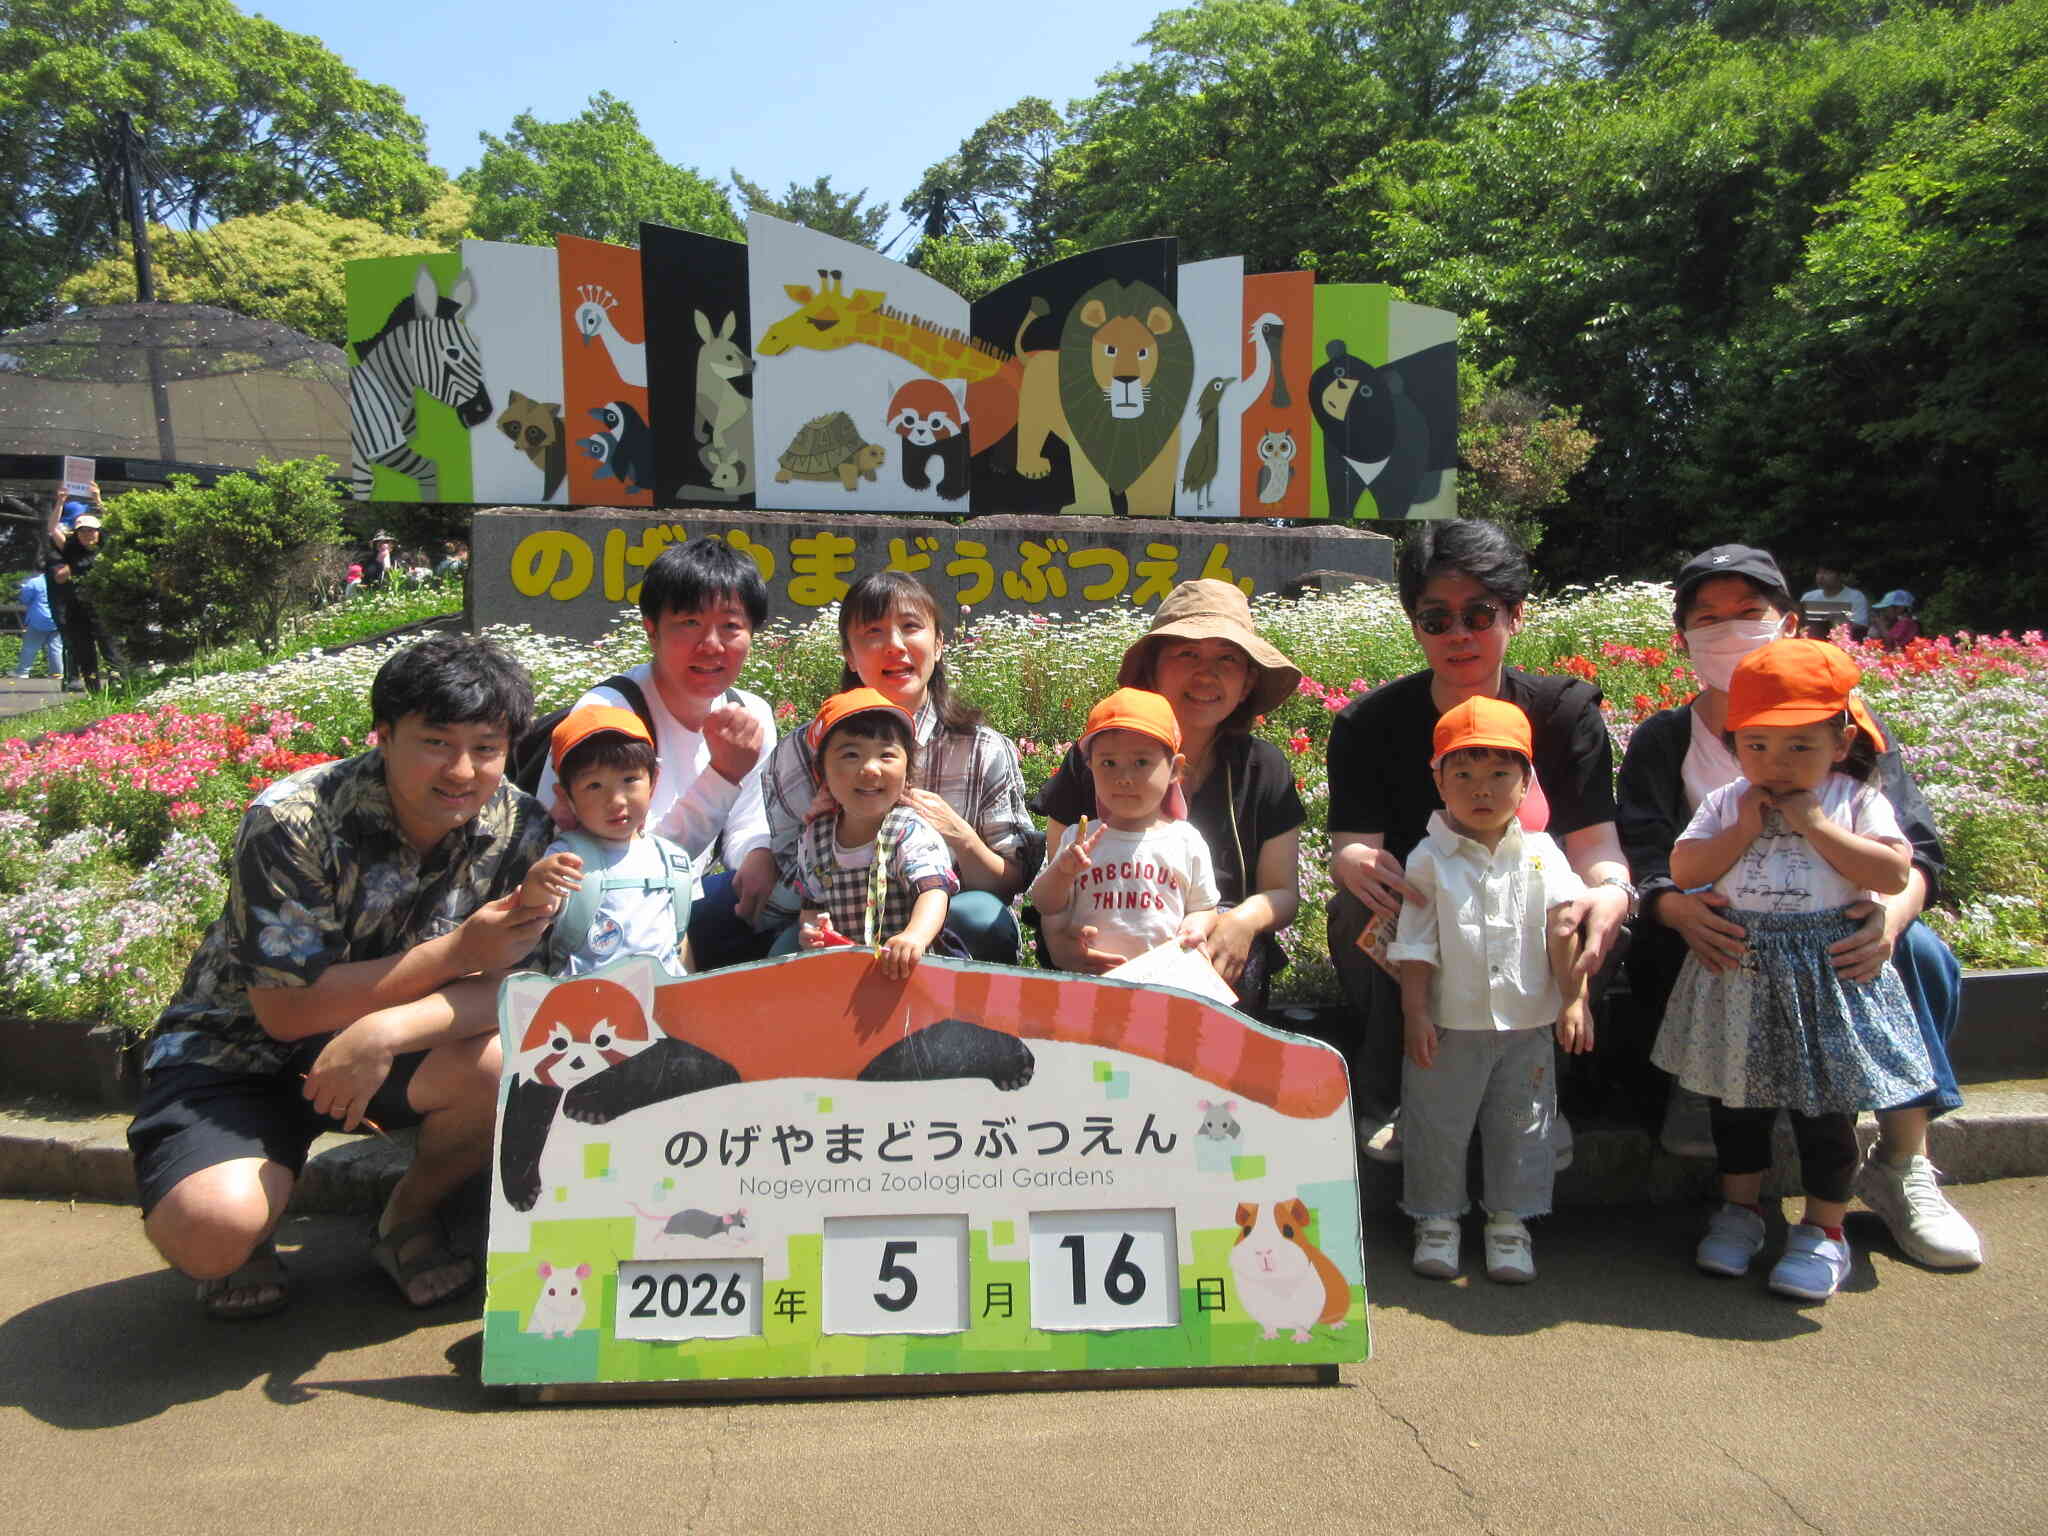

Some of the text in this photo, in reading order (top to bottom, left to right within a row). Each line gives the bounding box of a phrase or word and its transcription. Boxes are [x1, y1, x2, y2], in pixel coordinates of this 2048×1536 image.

[1092, 891, 1164, 910] THINGS
[664, 1113, 1177, 1169] のげやまどうぶつえん
[739, 1166, 1114, 1200] Nogeyama Zoological Gardens
[630, 1232, 1226, 1323] 2026 年 5 月 16 日
